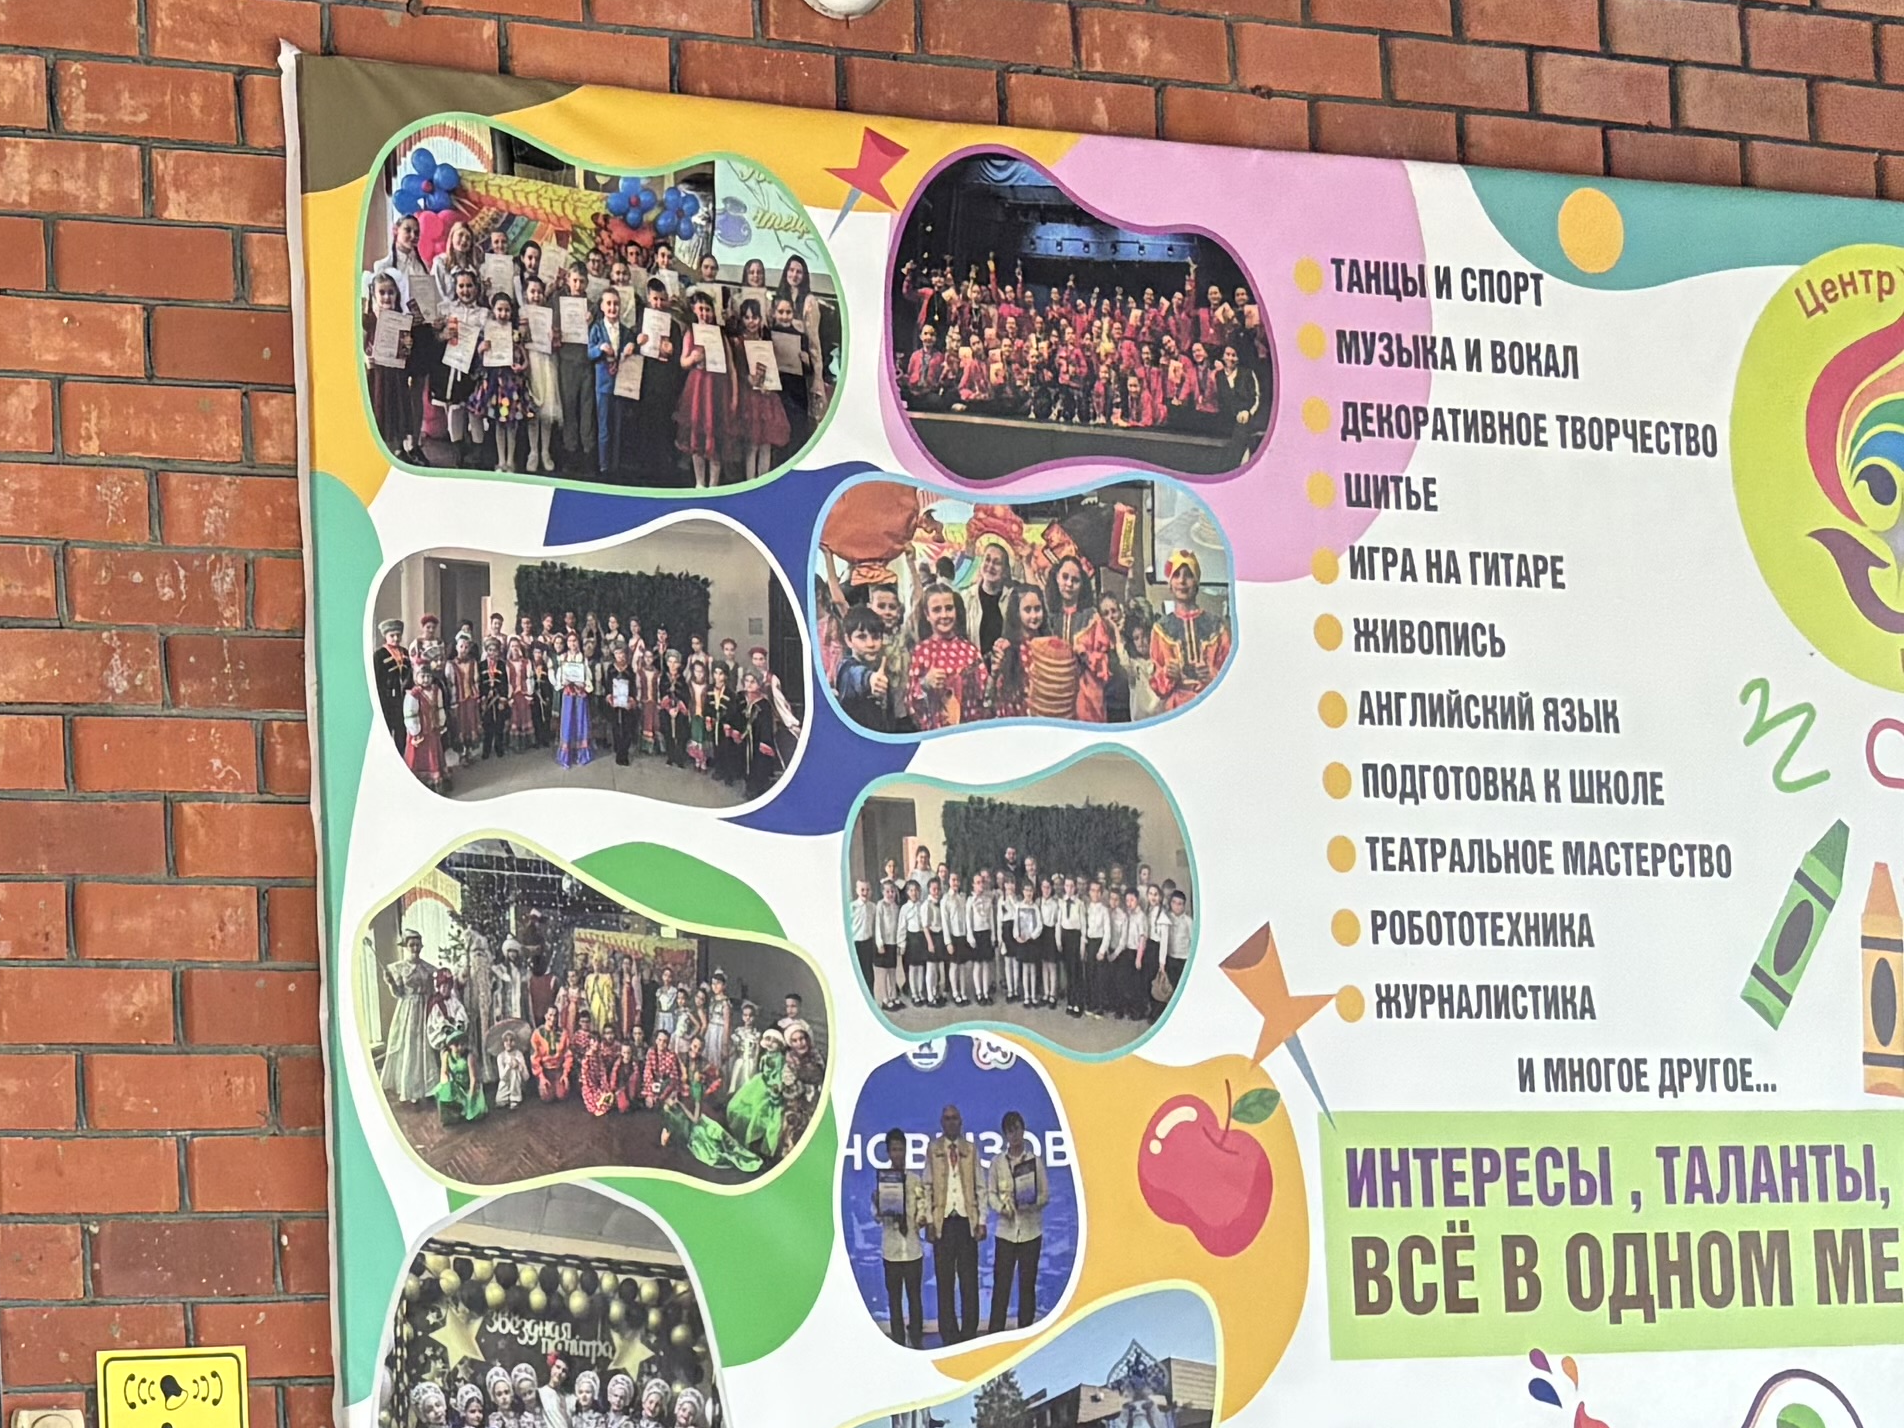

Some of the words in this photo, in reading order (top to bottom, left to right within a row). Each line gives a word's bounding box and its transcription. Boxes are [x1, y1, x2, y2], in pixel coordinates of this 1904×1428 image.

[1331, 257, 1427, 304] ТАНЦЫ
[1435, 266, 1452, 300] И
[1461, 268, 1544, 307] СПОРТ
[1794, 269, 1895, 319] Центр
[1335, 329, 1456, 372] МУЗЫКА
[1465, 338, 1482, 372] И
[1491, 340, 1579, 380] ВОКАЛ
[1340, 401, 1548, 449] ДЕКОРАТИВНОЕ
[1555, 415, 1717, 458] ТВОРЧЕСТВО
[1344, 473, 1438, 512] ШИТЬЕ
[1349, 545, 1417, 583] ИГРА
[1426, 548, 1462, 585] НА
[1470, 551, 1565, 589] ГИТАРЕ
[1353, 618, 1506, 658] ЖИВОПИСЬ
[1358, 688, 1535, 732] АНГЛИЙСКИЙ
[1543, 697, 1620, 734] ЯЗЫК
[1362, 763, 1536, 805] ПОДГОТОВКА
[1544, 768, 1561, 803] К
[1569, 769, 1664, 806] ШКОЛЕ
[1366, 836, 1553, 875] ТЕАТРАЛЬНОЕ
[1562, 841, 1731, 879] МАСТЕРСТВО
[1370, 910, 1594, 947] РОБОТОТЕХНИКА
[1375, 983, 1596, 1020] ЖУРНАЛИСТИКА
[1517, 1057, 1536, 1093] И
[1544, 1058, 1649, 1094] МНОГОЕ
[1659, 1057, 1777, 1099] ДРУГОЕ...
[1655, 1144, 1891, 1210] ТАЛАНТЫ,
[1351, 1220, 1479, 1316] ВСЁ
[1501, 1234, 1542, 1314] В
[1565, 1228, 1794, 1325] ОДНОМ
